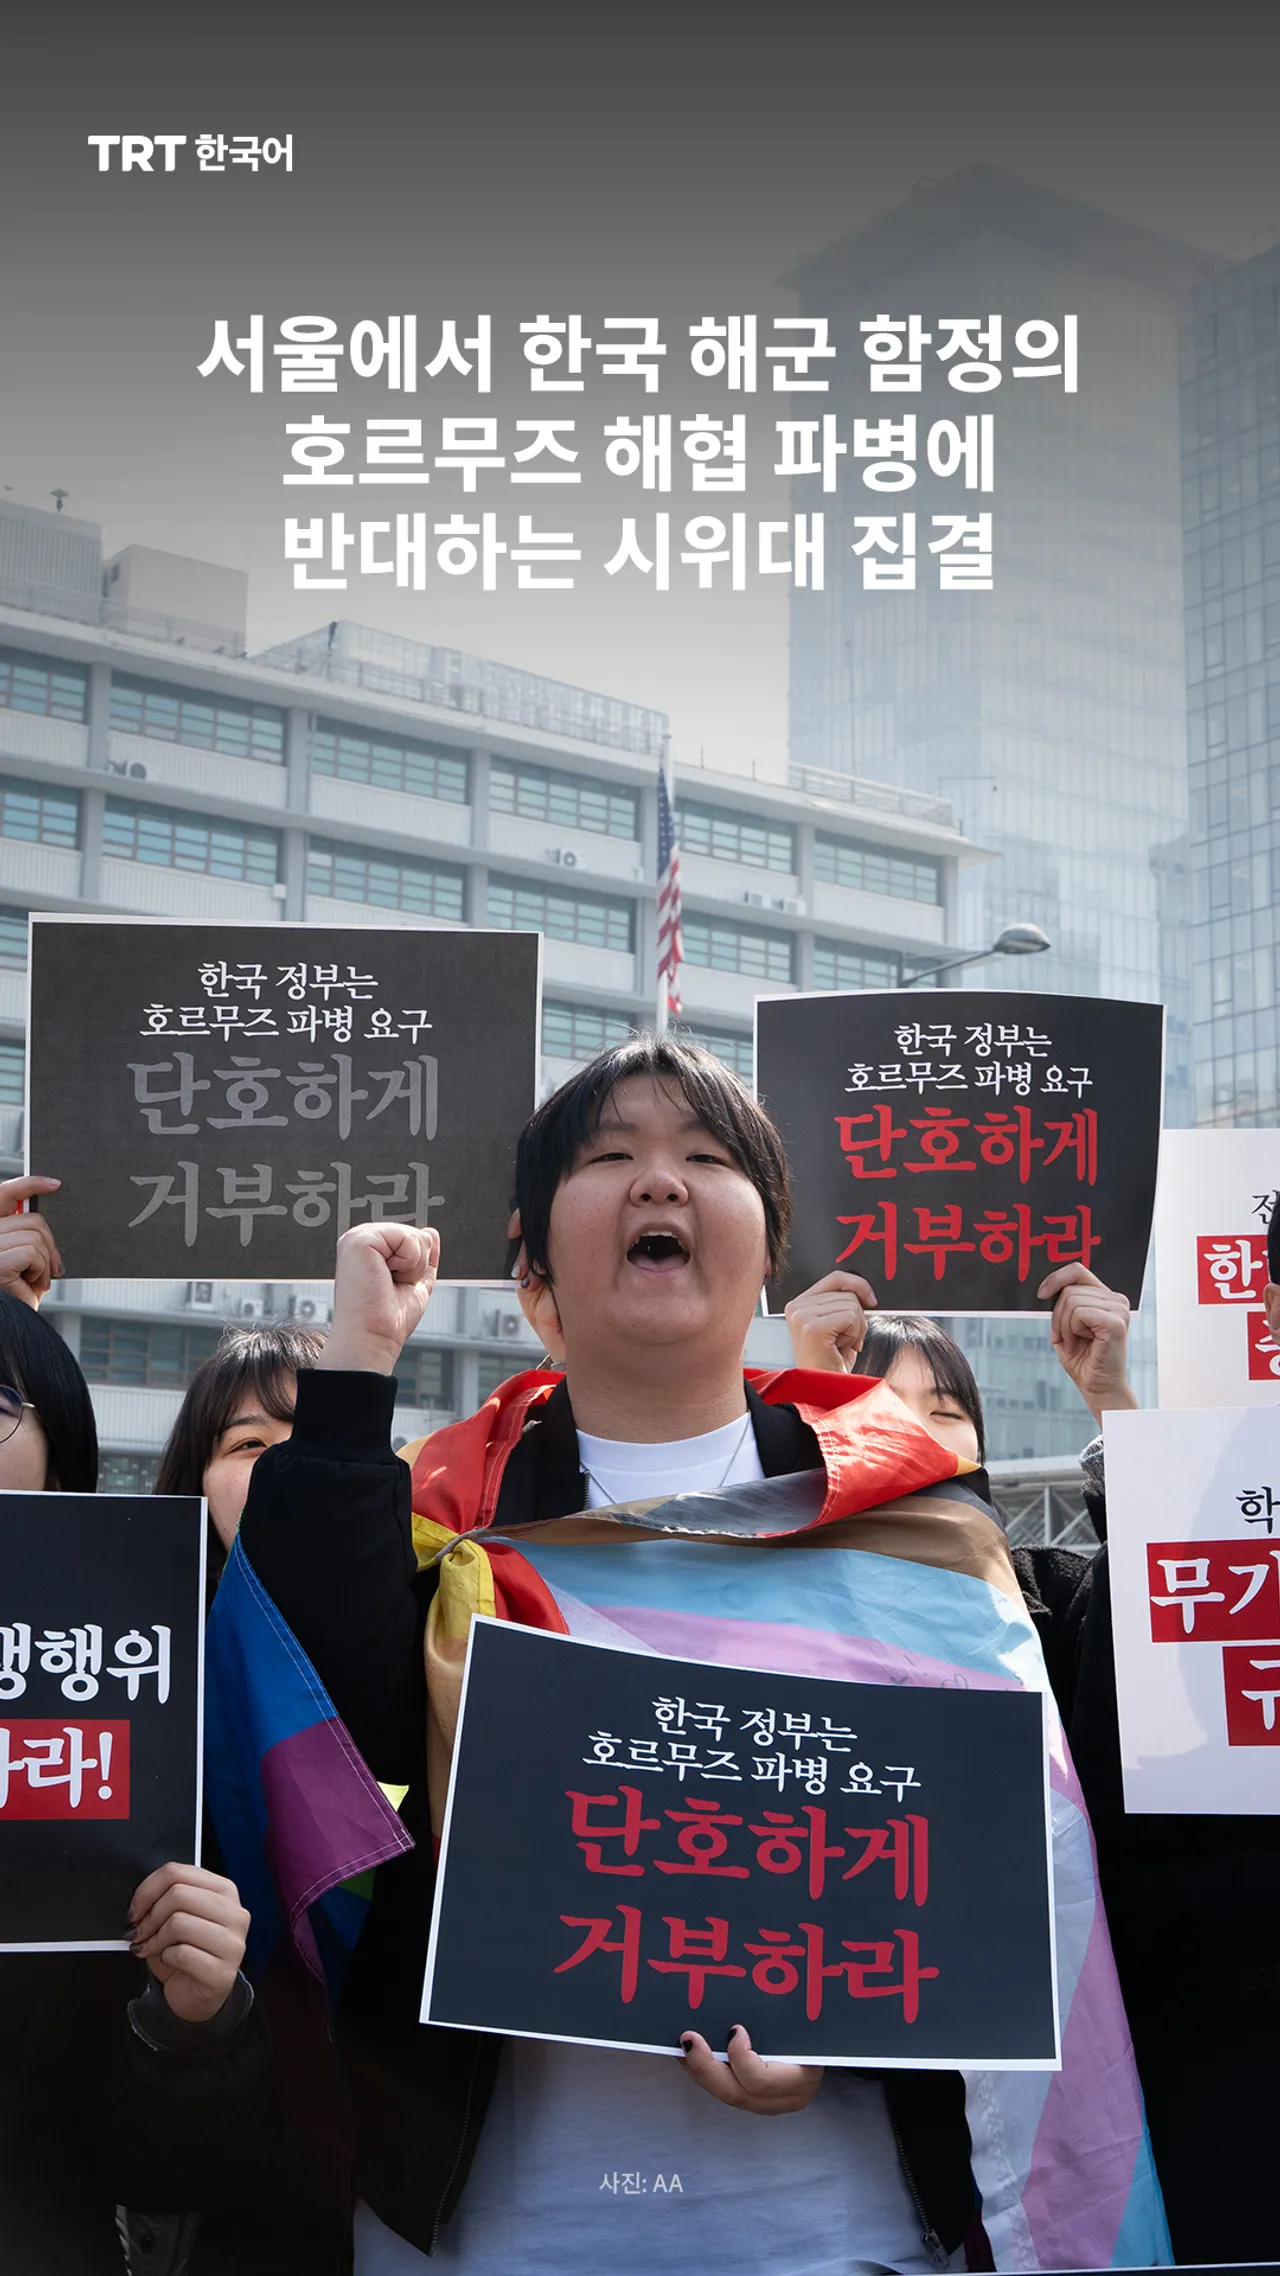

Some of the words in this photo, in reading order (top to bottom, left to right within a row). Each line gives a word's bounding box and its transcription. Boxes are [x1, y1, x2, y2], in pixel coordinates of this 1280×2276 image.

[198, 961, 267, 999] 한국
[276, 963, 378, 1001] 정부는
[140, 1004, 279, 1041] 호르무즈
[287, 1005, 352, 1042] 파병
[364, 1008, 432, 1044] 요구
[895, 1023, 956, 1056] 한국
[965, 1023, 1052, 1057] 정부는
[127, 1052, 438, 1141] 단호하게
[845, 1063, 967, 1093] 호르무즈
[975, 1061, 1031, 1095] 파병
[1041, 1065, 1092, 1097] 요구
[834, 1104, 1096, 1185] 단호하게
[835, 1202, 1101, 1281] 거부하라
[1203, 1239, 1269, 1300] 한
[651, 1697, 731, 1735] 한국
[740, 1708, 858, 1750] 정부는
[582, 1731, 741, 1783] 호르무즈
[750, 1752, 829, 1796] 파병
[841, 1762, 921, 1802] 요구
[566, 1785, 929, 1907] 단호하게
[554, 1905, 940, 2023] 거부하라
